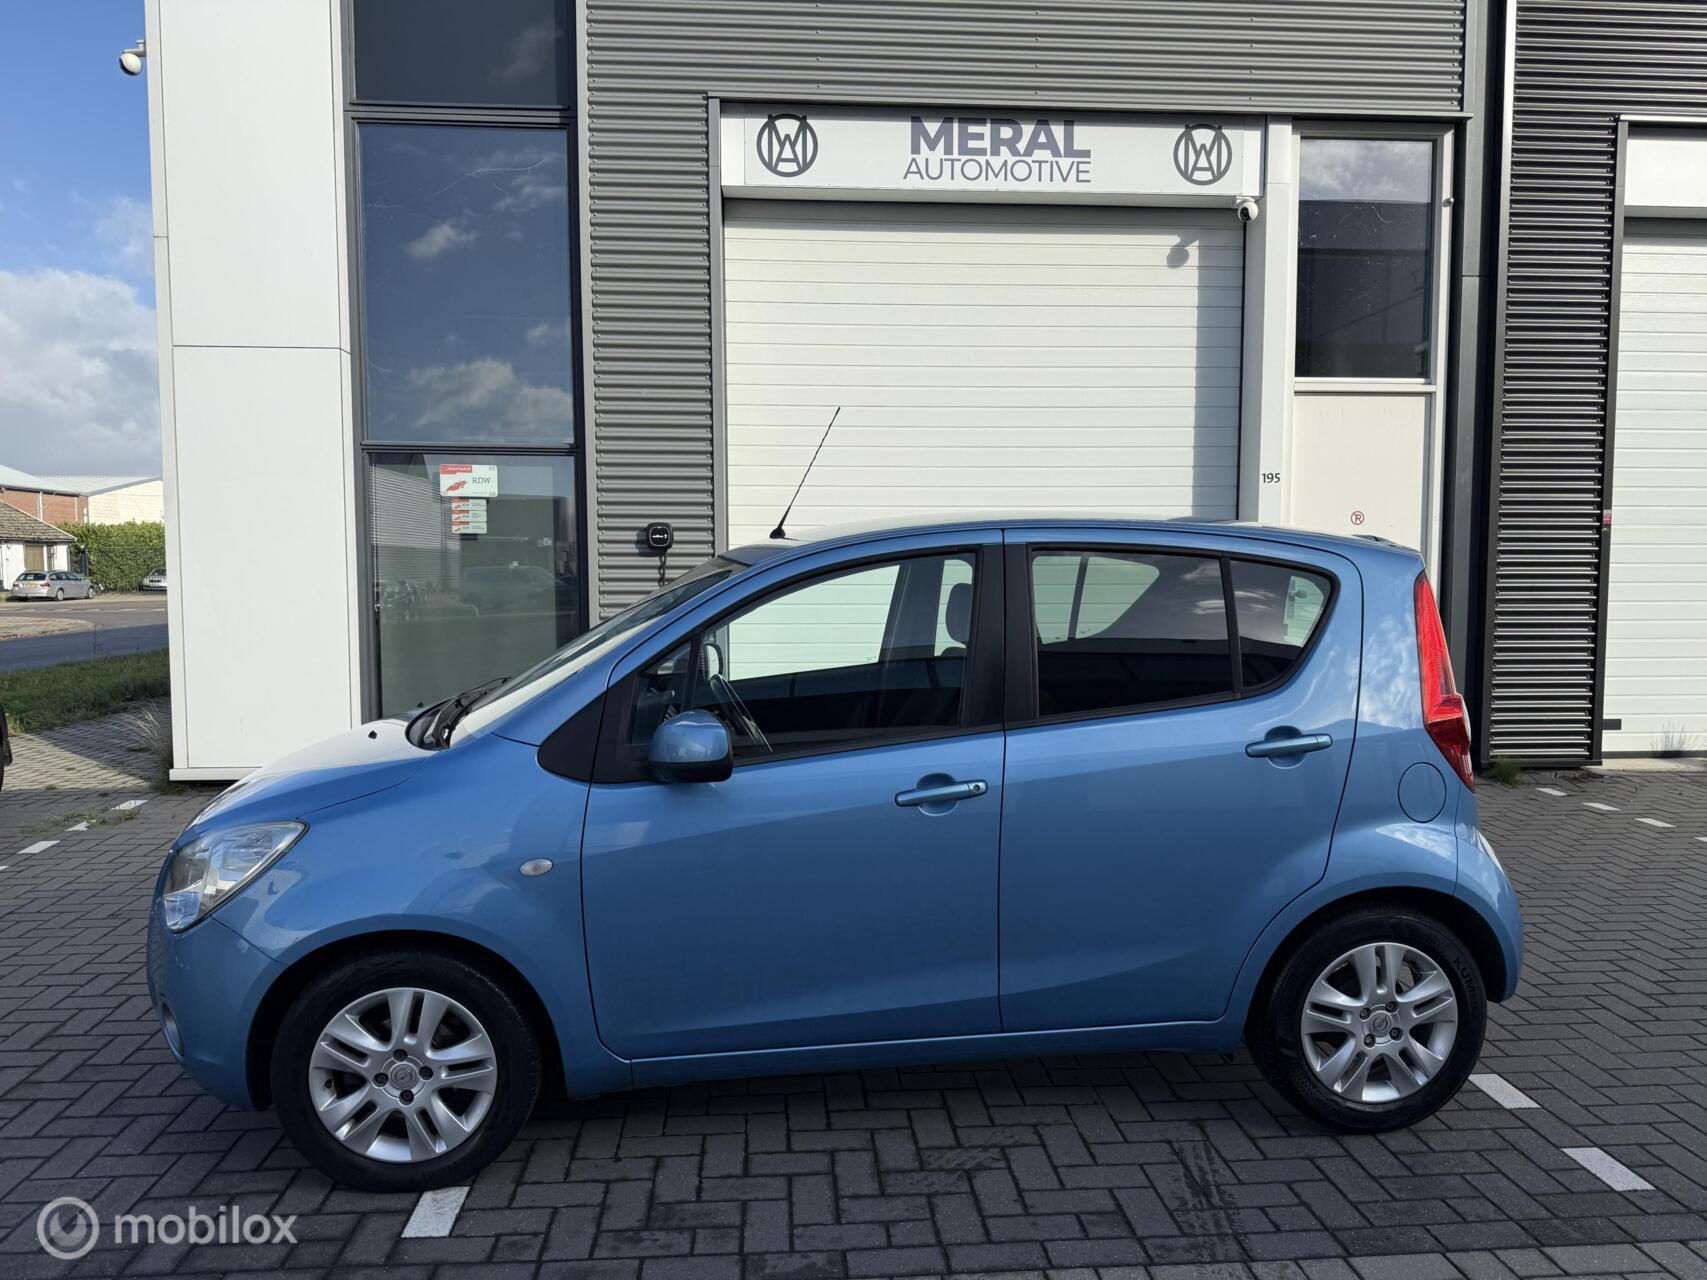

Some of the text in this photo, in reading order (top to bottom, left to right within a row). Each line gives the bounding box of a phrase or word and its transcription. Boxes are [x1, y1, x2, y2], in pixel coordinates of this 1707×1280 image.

[910, 116, 1092, 159] MERAL
[902, 157, 1092, 183] AUTOMOTIVE
[471, 476, 491, 484] RDW
[1261, 472, 1281, 484] 195
